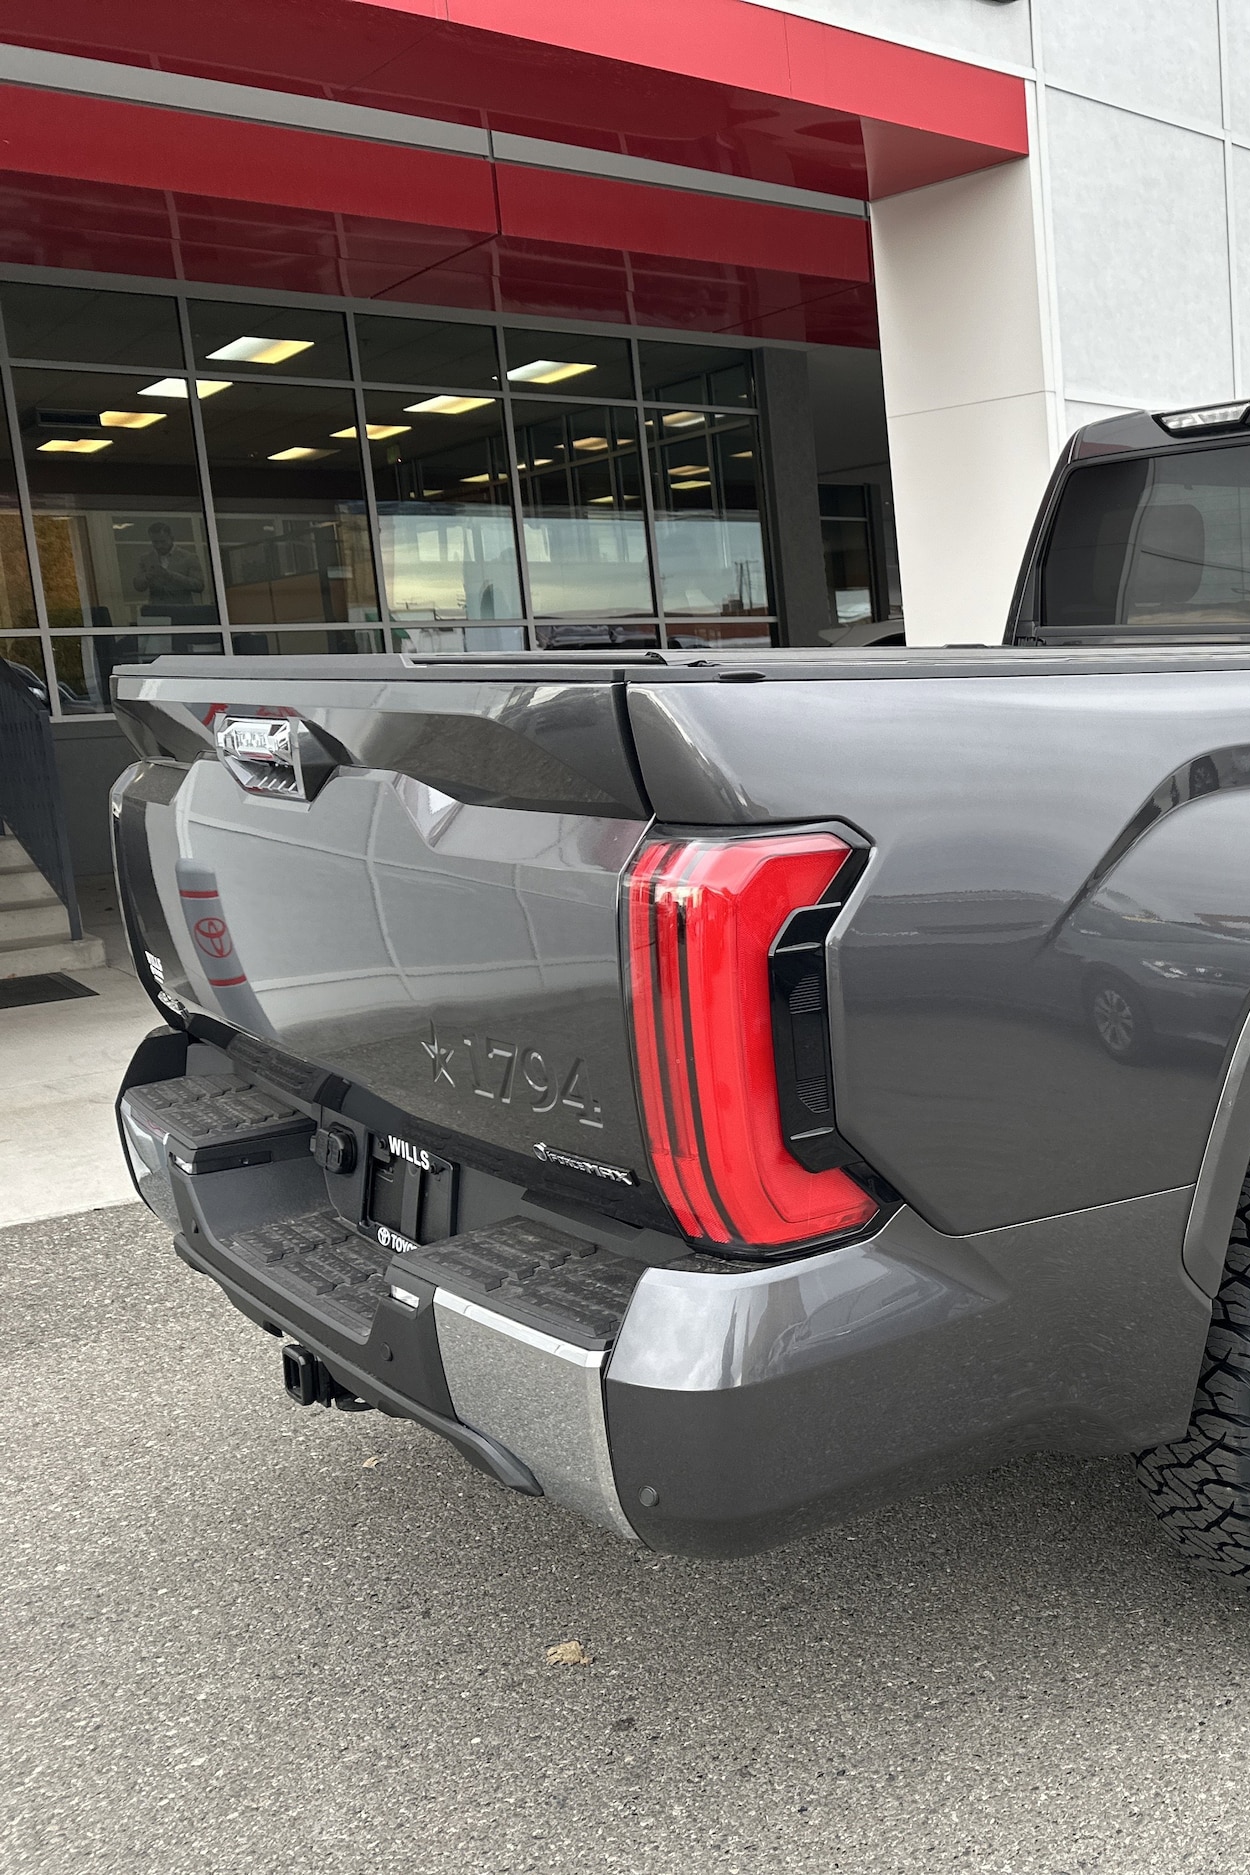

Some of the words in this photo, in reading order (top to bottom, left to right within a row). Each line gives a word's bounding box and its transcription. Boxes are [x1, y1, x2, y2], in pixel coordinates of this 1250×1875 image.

[462, 1033, 603, 1128] 1794
[388, 1135, 430, 1171] WILLS
[391, 1233, 418, 1253] TOYO
